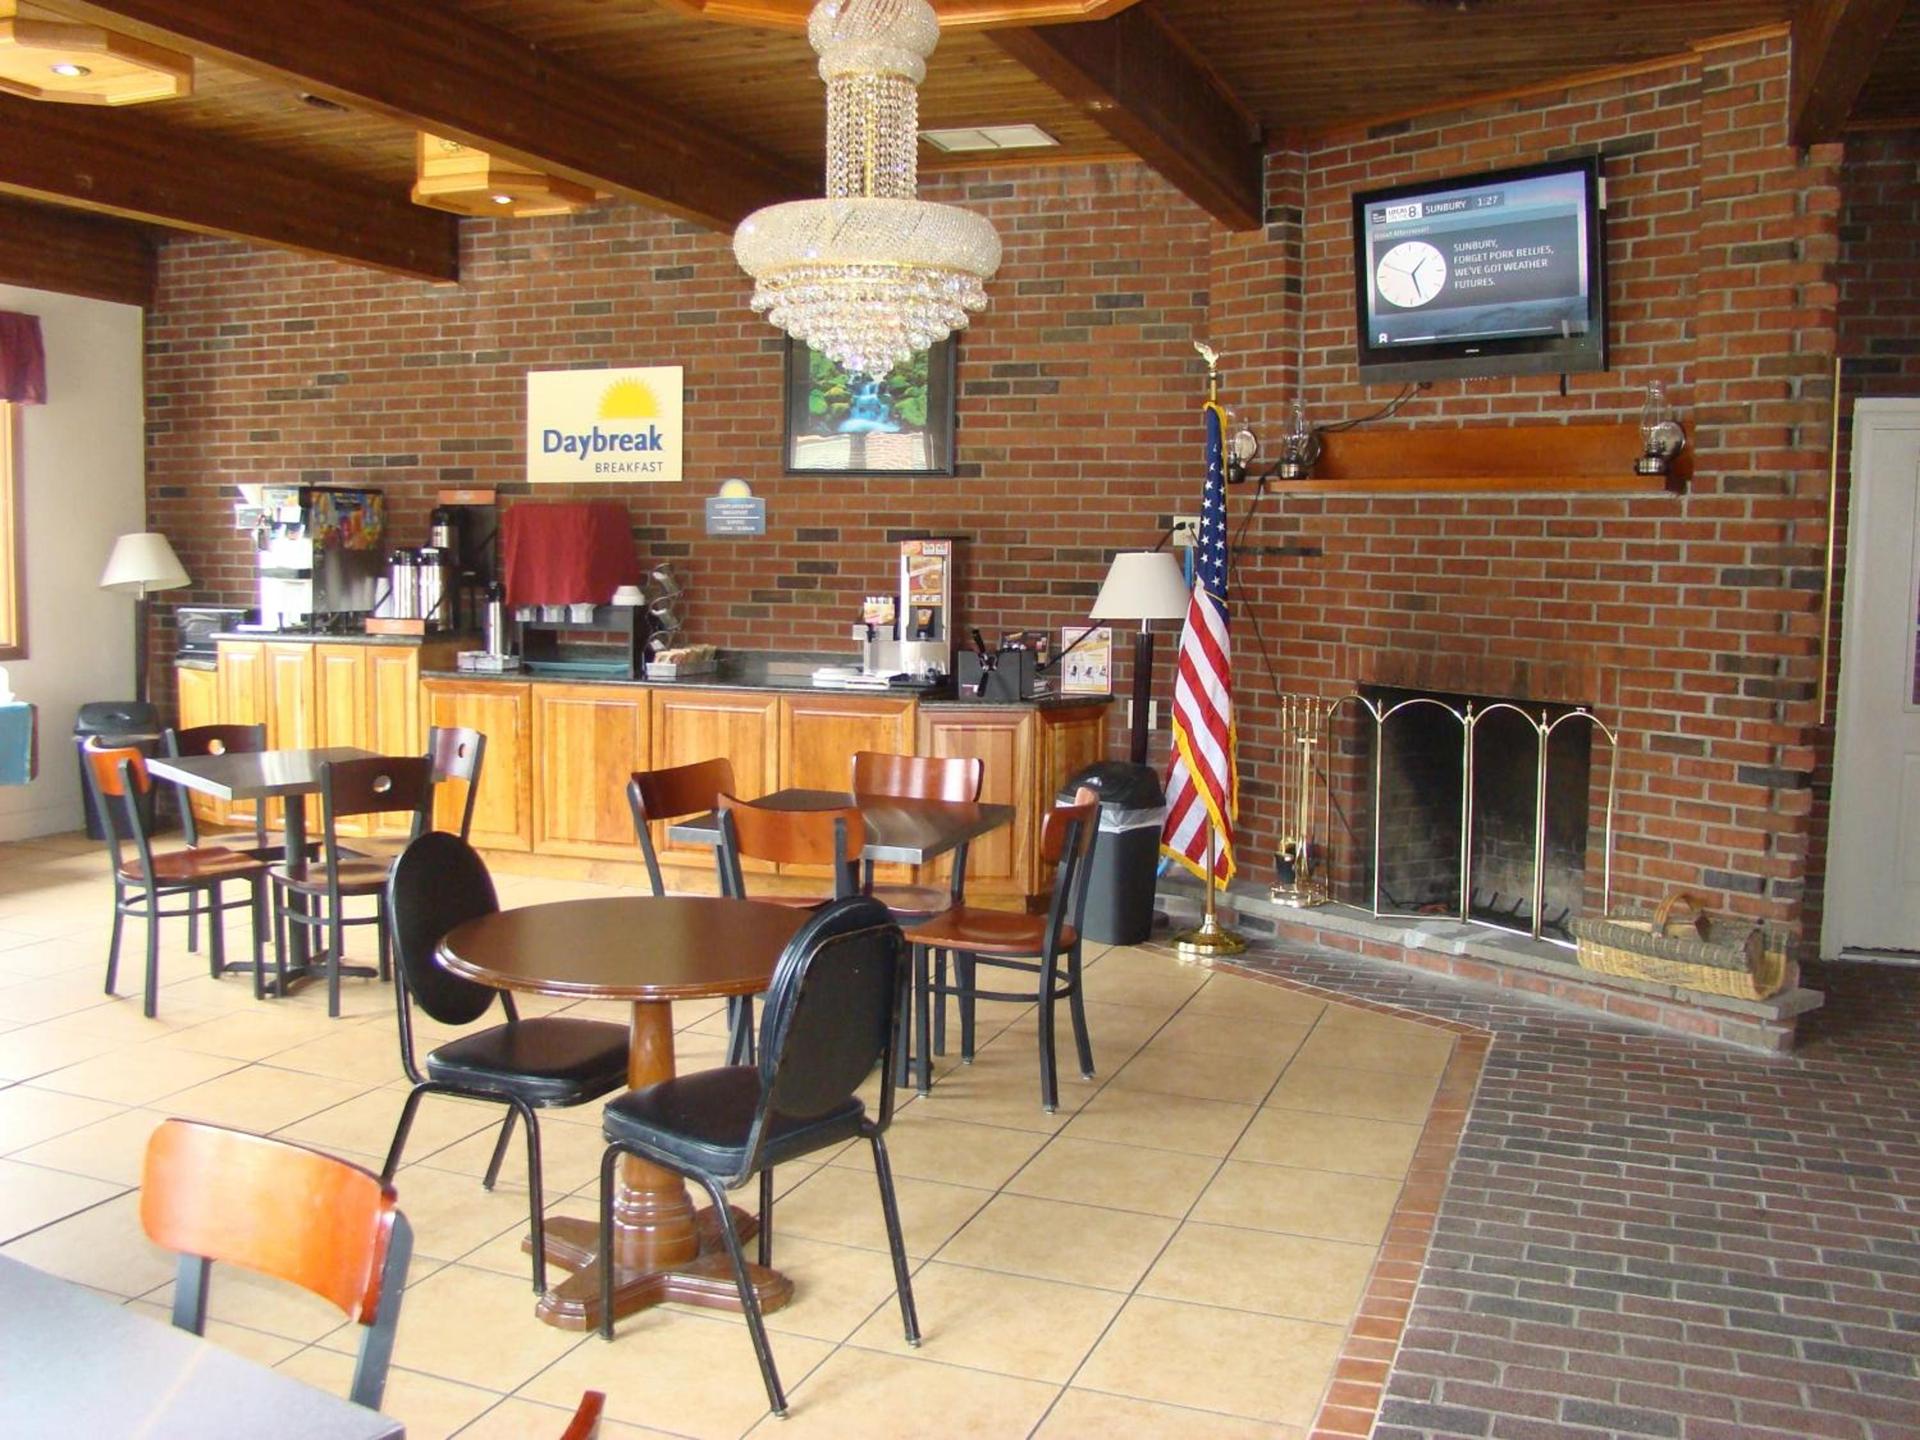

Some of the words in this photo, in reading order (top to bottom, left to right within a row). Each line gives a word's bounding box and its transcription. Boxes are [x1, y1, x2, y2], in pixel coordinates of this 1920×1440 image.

[1425, 200, 1467, 215] SUNBURY
[1477, 195, 1499, 207] 1:27
[1453, 252, 1488, 265] FORGET
[1489, 248, 1515, 261] PORK
[1454, 265, 1482, 277] WE'VE
[1483, 262, 1503, 273] GOT
[1503, 258, 1548, 272] WEATHER
[543, 425, 663, 460] Daybreak
[595, 461, 664, 473] BREAKFAST
